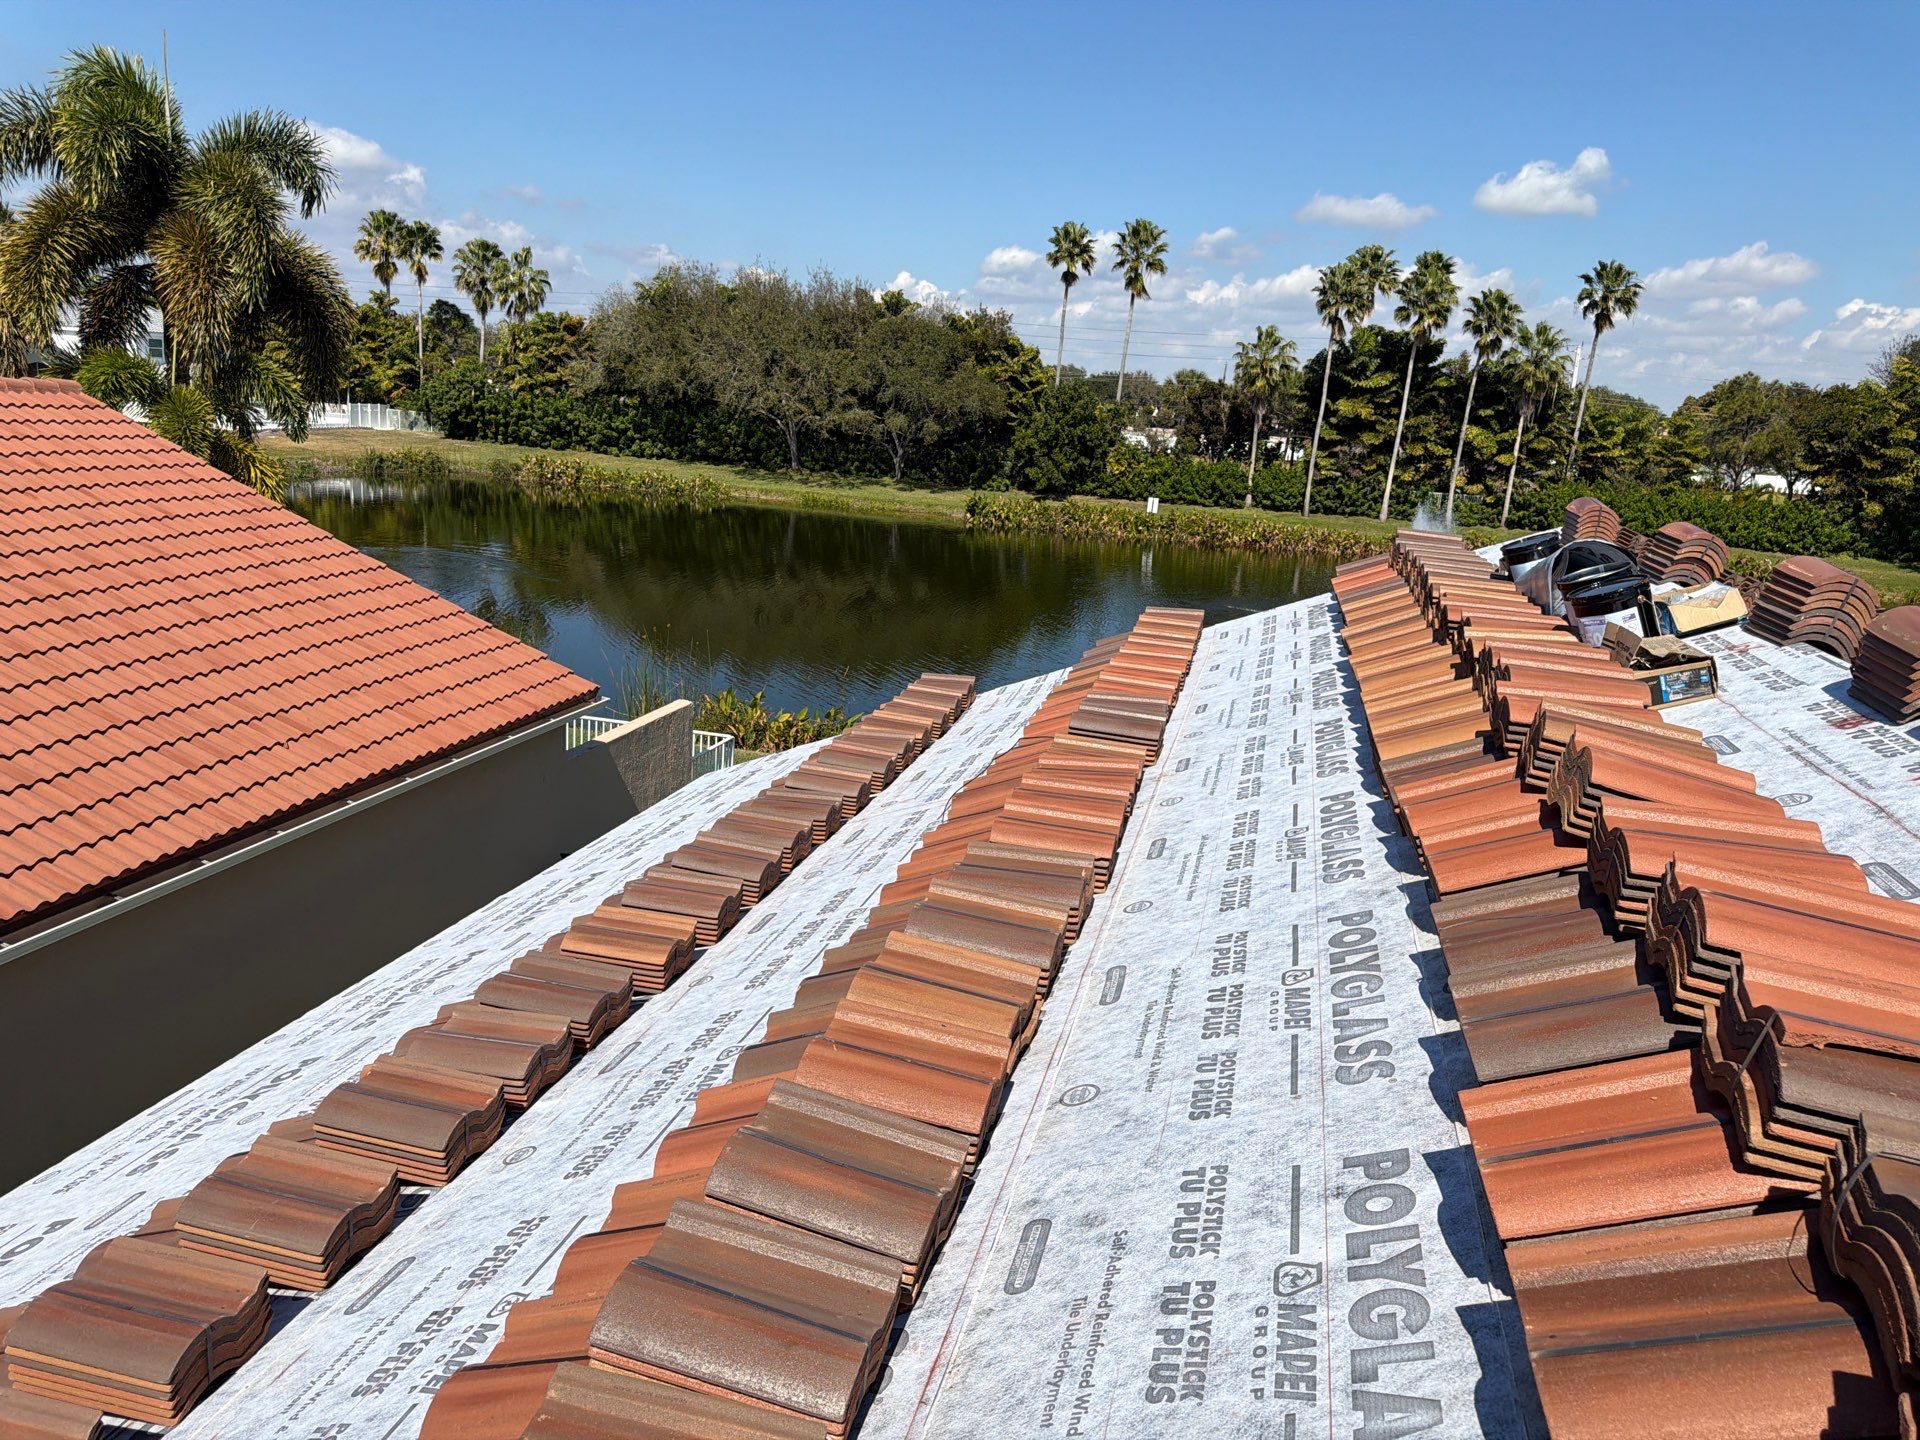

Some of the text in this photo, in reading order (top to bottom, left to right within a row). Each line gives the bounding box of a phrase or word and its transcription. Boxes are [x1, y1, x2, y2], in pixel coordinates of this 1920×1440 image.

[1315, 718, 1349, 778] POLYGLASS
[1846, 729, 1906, 758] TU PLUS
[1226, 841, 1244, 871] TU PLUS
[1319, 791, 1365, 884] POLYGLASS
[1219, 877, 1239, 913] TU PLUS
[1237, 874, 1252, 910] POLYSTICK
[1211, 933, 1233, 977] TU PLUS
[1232, 930, 1249, 975] POLYSTICK
[1201, 987, 1227, 1039] TU PLUS
[1224, 984, 1244, 1037] POLYSTICK
[1269, 991, 1279, 1031] GROUP
[1284, 987, 1311, 1029] MAPEI
[1327, 909, 1395, 1085] POLYGLASS
[630, 1059, 681, 1111] TU PLUS
[1188, 1054, 1218, 1121] TU PLUS
[1214, 1051, 1237, 1118] POLYSTICK
[563, 1145, 605, 1180] PLUS
[584, 1121, 639, 1179] POLYSTICK
[602, 1125, 624, 1141] TU
[1169, 1167, 1206, 1259] TU PLUS
[1199, 1164, 1229, 1257] POLYSTICK
[457, 1217, 538, 1290] TU PLUS
[474, 1216, 550, 1288] POLYSTICK
[351, 1310, 446, 1397] TU PLUS
[367, 1306, 464, 1397] POLYSTICK
[420, 1323, 499, 1395] MAPEI
[1040, 1295, 1088, 1428] Tile Underlayment
[1066, 1229, 1128, 1437] Self-Adhered Reinforced Wind
[1145, 1282, 1191, 1404] TU PLUS
[1179, 1280, 1217, 1403] POLYSTICK
[1250, 1305, 1269, 1400] GROUP
[1274, 1303, 1317, 1402] MAPEI
